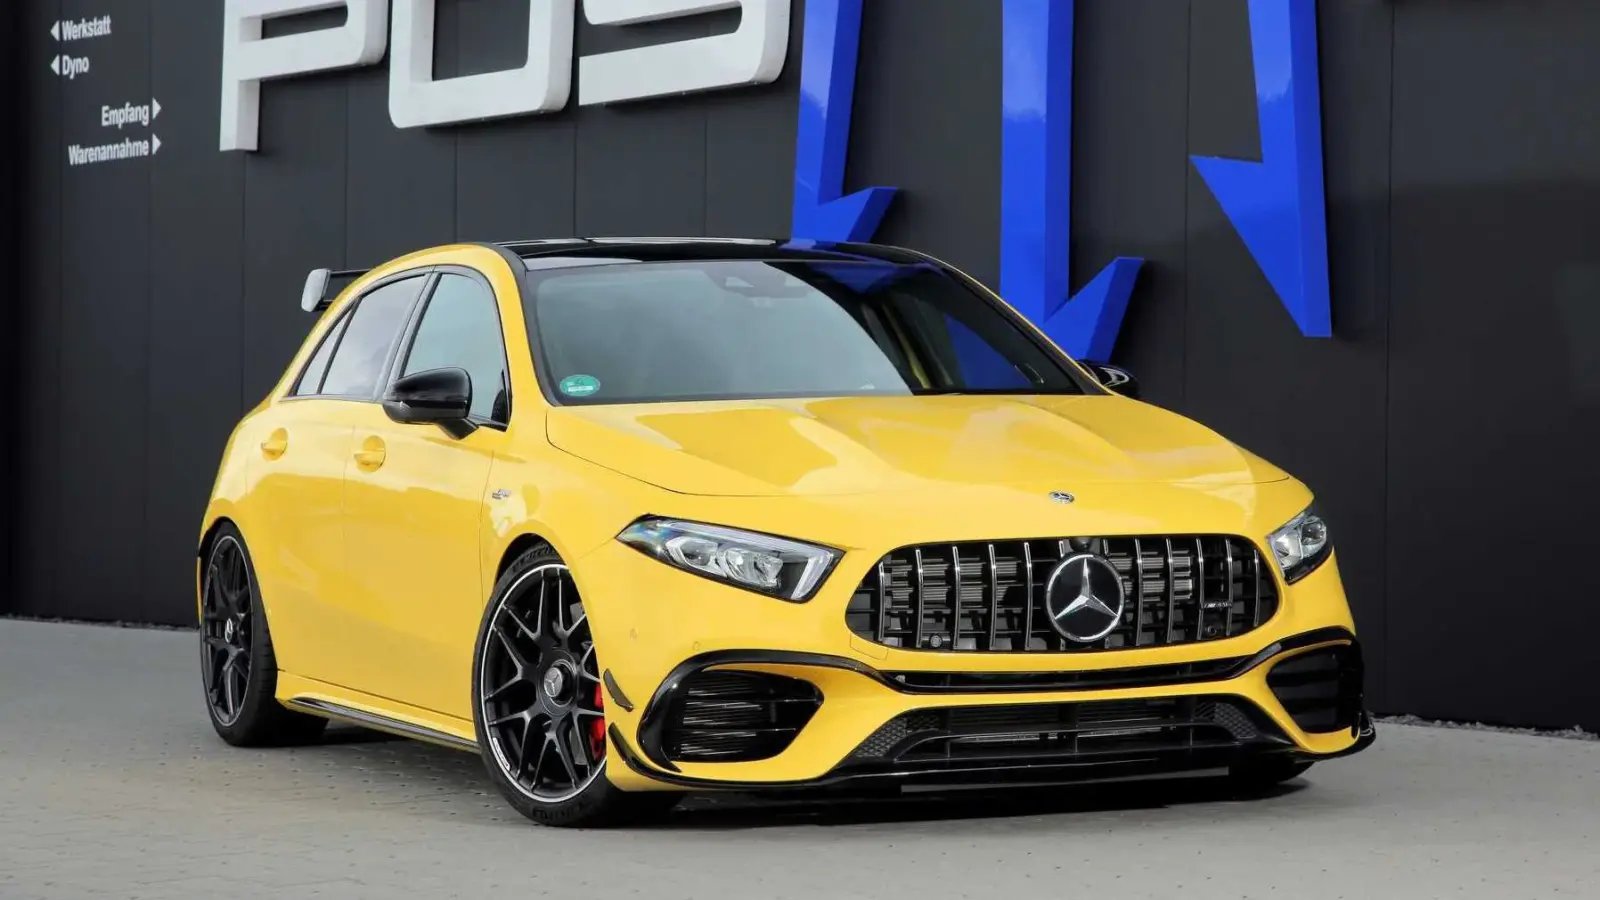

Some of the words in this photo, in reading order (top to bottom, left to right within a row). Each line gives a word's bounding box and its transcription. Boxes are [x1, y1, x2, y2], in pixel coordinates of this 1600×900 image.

[61, 14, 111, 40] Werkstatt
[62, 54, 89, 79] Dyno
[101, 101, 149, 129] Empfang
[68, 137, 149, 166] Warenannahme
